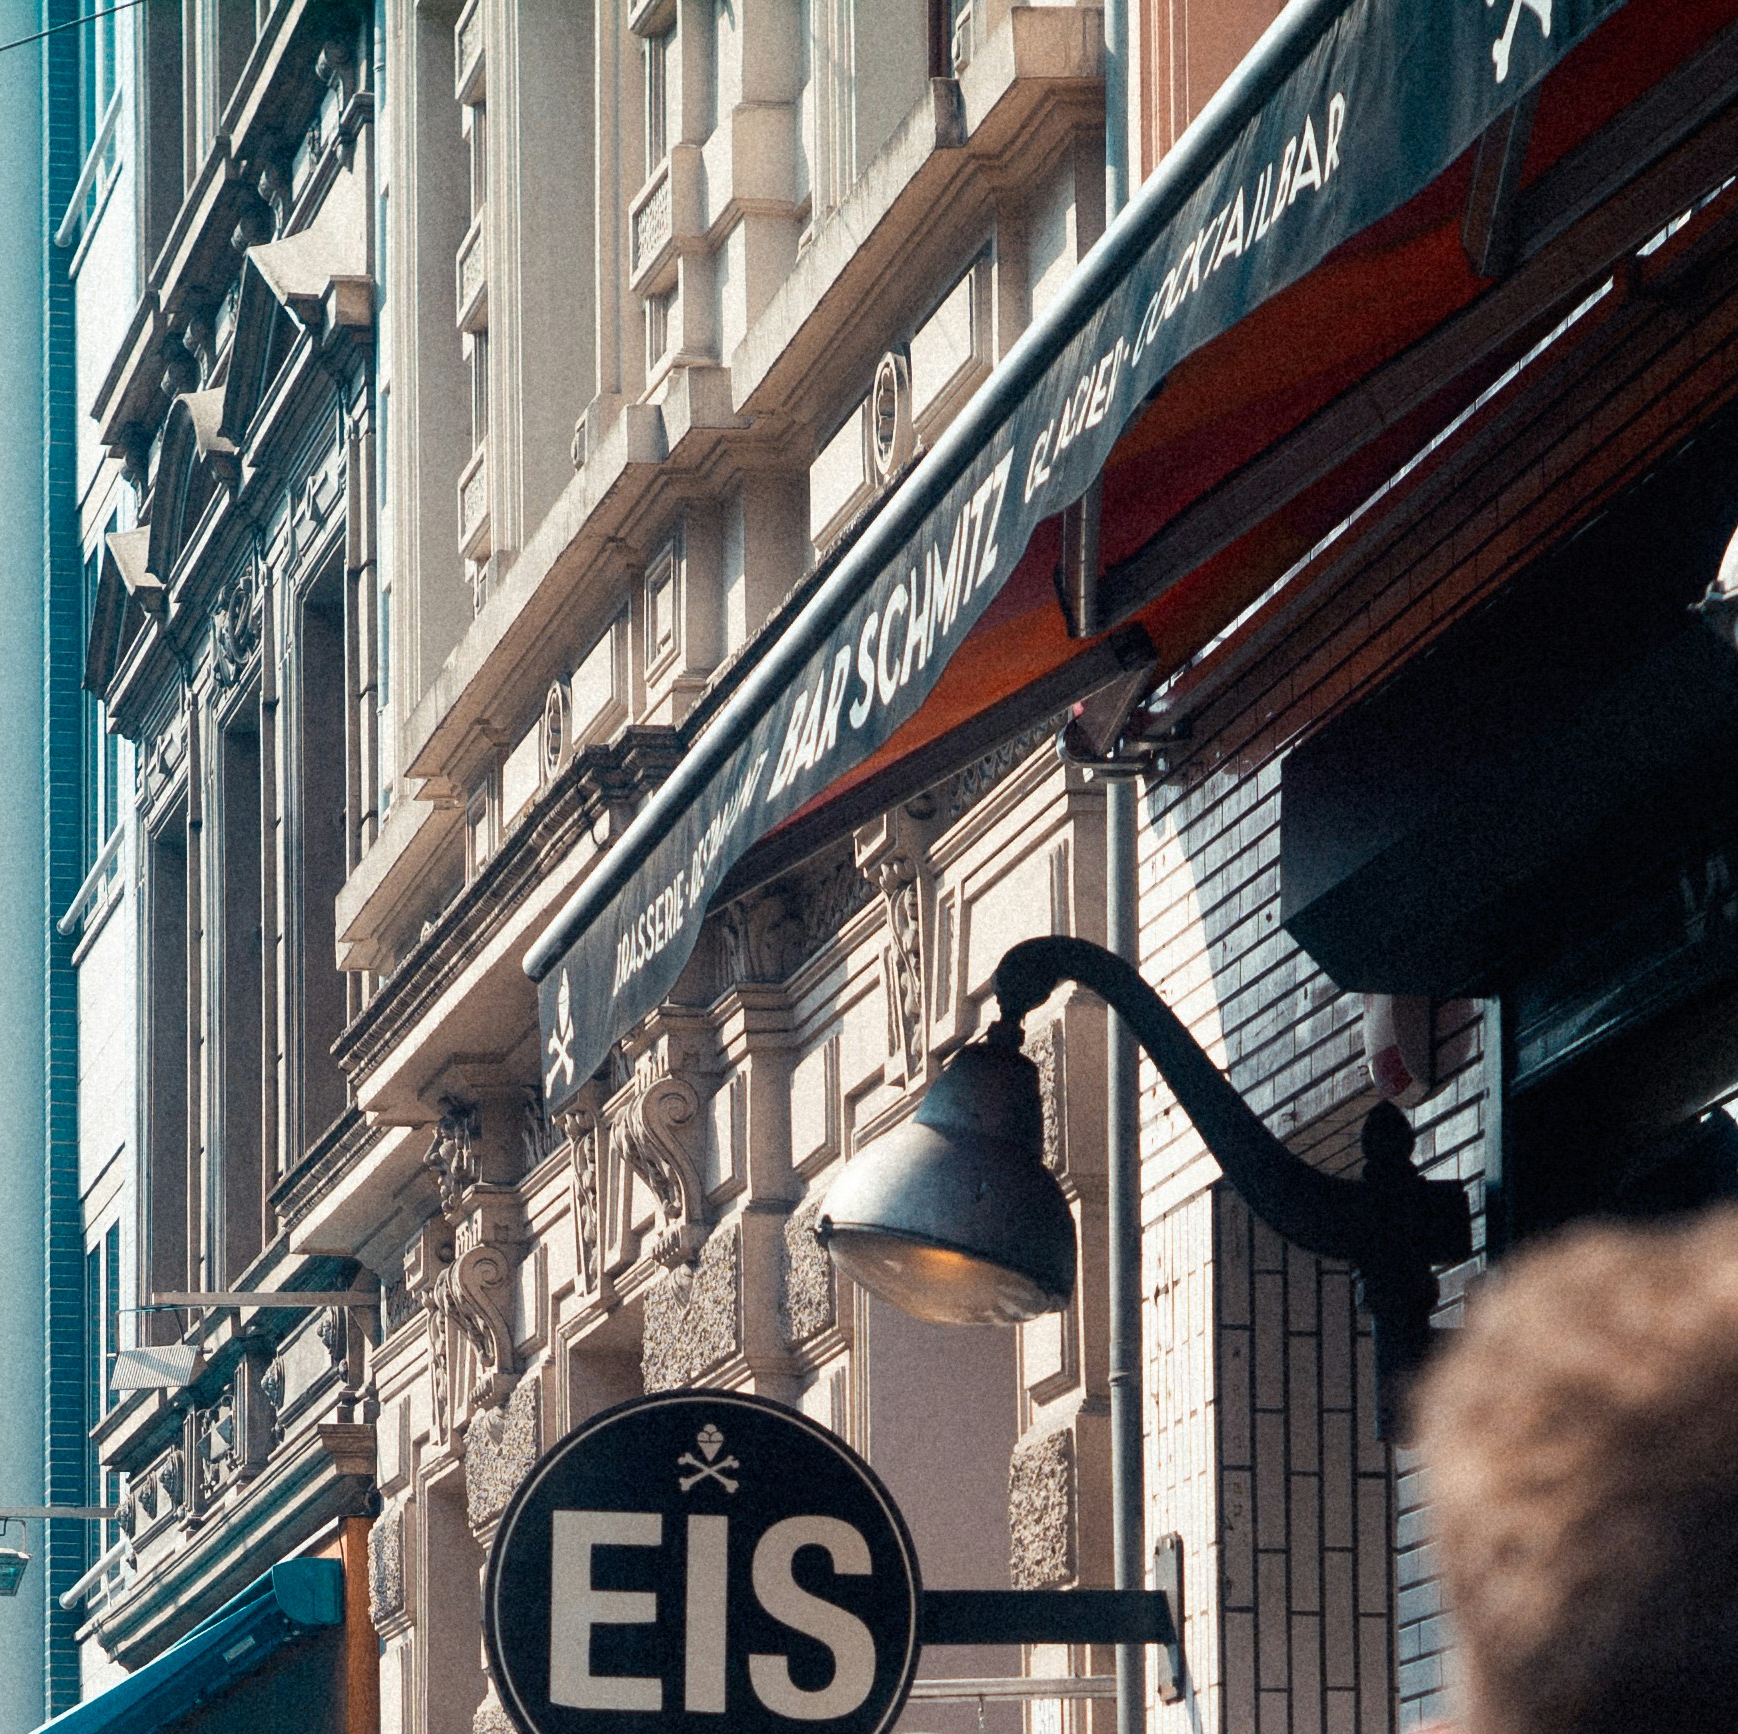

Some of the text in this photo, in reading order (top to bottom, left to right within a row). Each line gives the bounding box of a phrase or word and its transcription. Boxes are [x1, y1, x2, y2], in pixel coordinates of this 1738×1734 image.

[766, 644, 851, 802] BAR
[849, 446, 1014, 730] SCHMITZ
[1131, 92, 1346, 367] COCKTAILBAR
[549, 1510, 876, 1721] EIS
